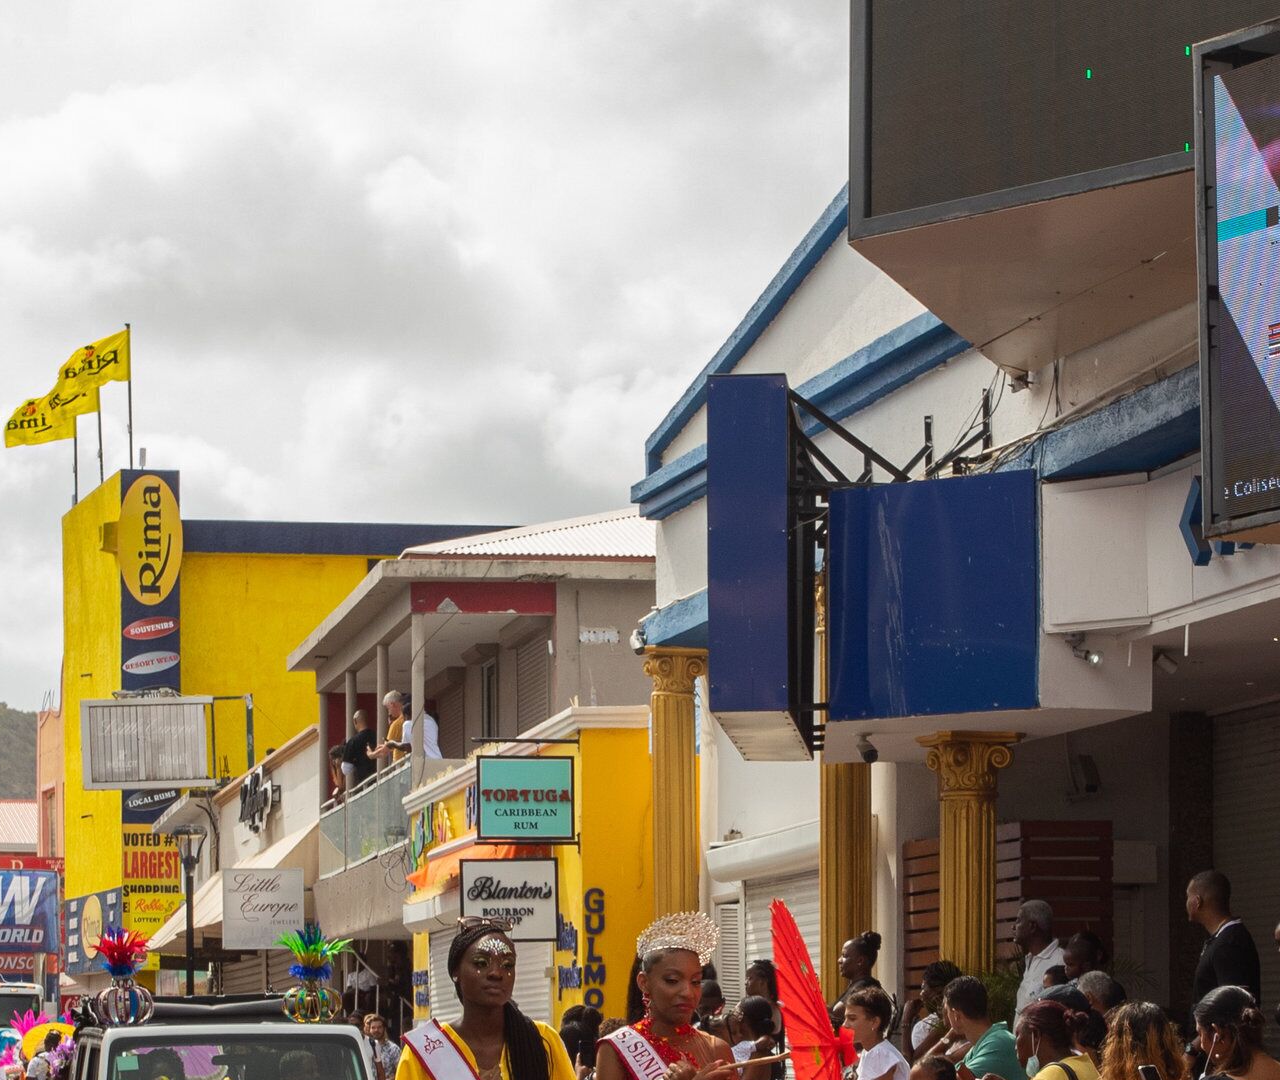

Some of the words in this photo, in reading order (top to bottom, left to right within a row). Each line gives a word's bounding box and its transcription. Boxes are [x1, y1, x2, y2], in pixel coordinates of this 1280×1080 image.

[137, 484, 171, 597] Rima
[129, 620, 175, 635] SOUVENIRS
[125, 660, 155, 670] RESORT
[128, 797, 153, 808] LOCAL
[154, 790, 177, 802] RUMS
[482, 788, 571, 803] TORTUGA
[494, 808, 558, 817] CARIBBEAN
[513, 821, 539, 830] RUM
[123, 833, 160, 847] VOTED
[123, 851, 179, 880] LARGEST
[228, 872, 282, 893] Little
[467, 876, 553, 900] Blanton's
[239, 893, 298, 919] Europe
[482, 907, 535, 917] BOURBON
[583, 887, 607, 1010] GULMO
